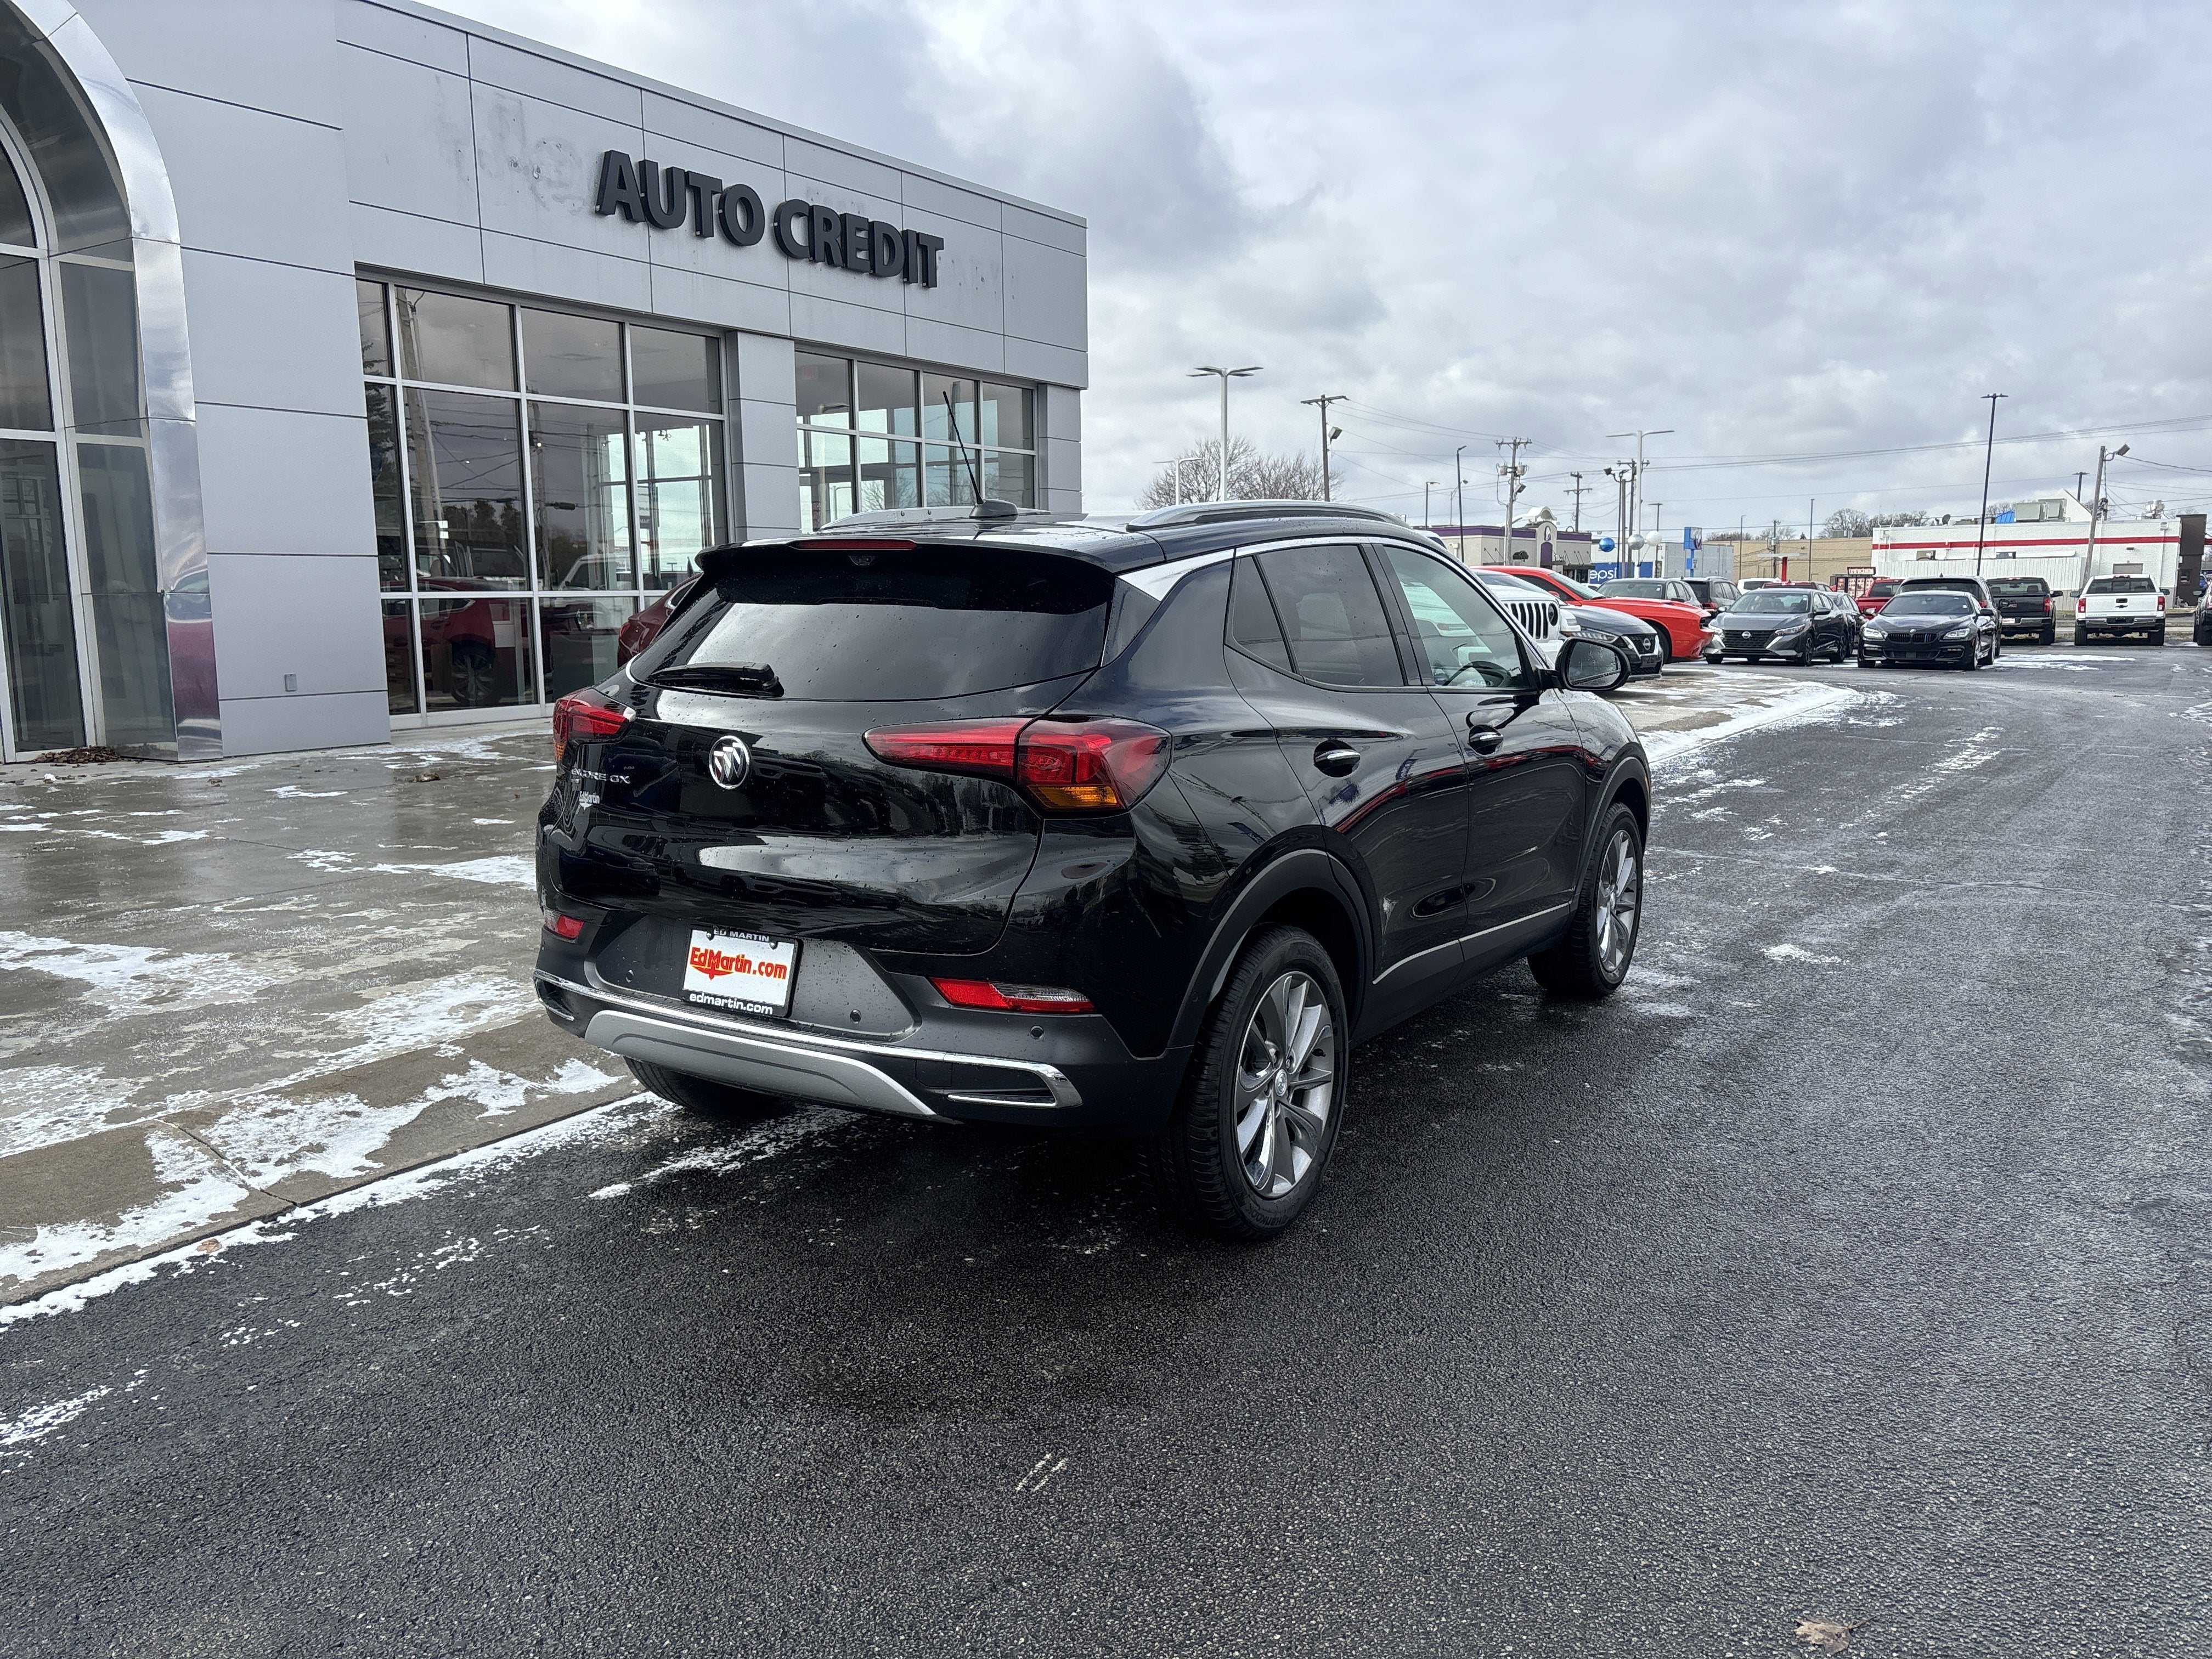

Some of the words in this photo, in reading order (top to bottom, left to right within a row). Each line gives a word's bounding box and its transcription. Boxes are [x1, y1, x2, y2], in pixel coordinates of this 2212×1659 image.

[595, 150, 765, 246] AUTO
[774, 199, 944, 288] CREDIT
[1589, 567, 1617, 582] epsi
[610, 775, 630, 784] GX
[730, 930, 770, 942] MARTIN
[690, 946, 787, 980] EdMartin.com
[689, 992, 773, 1015] edmartin.com
